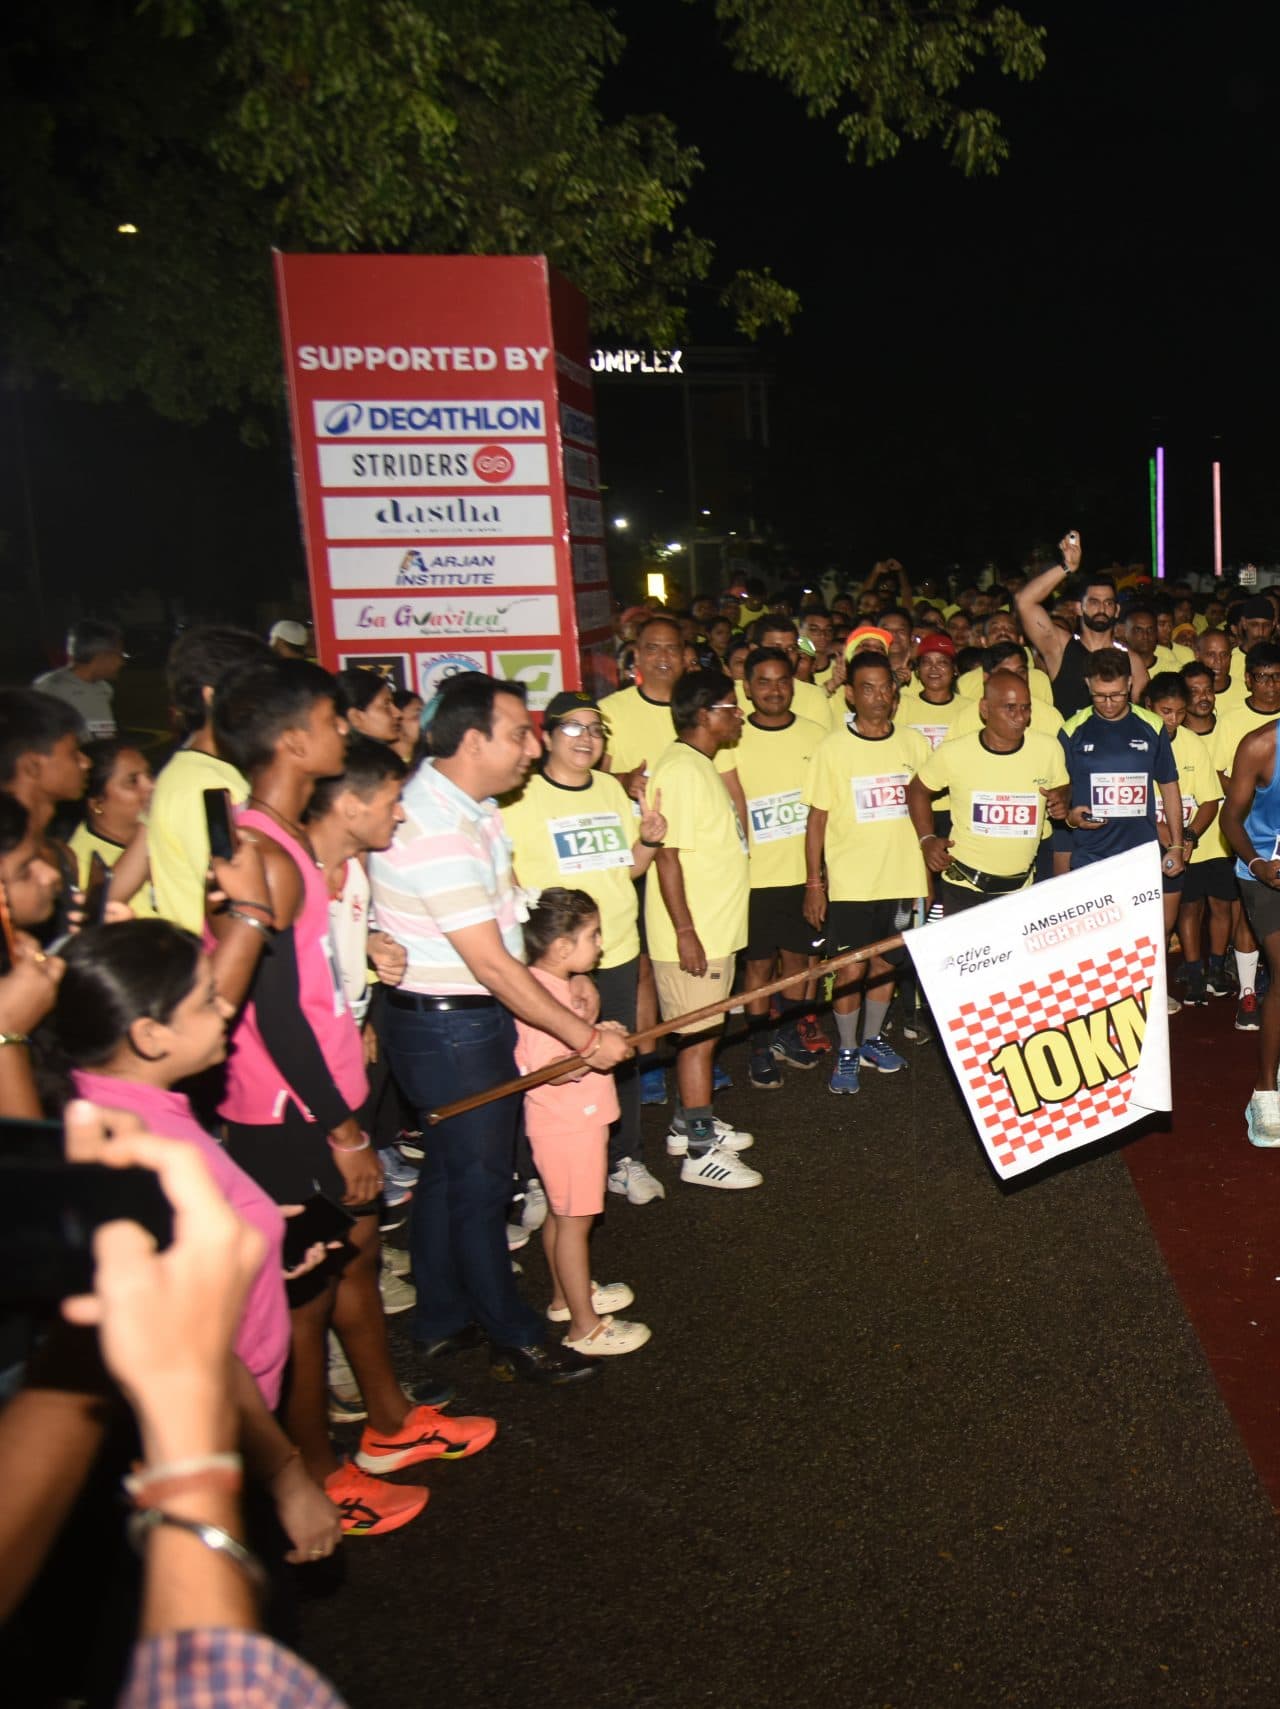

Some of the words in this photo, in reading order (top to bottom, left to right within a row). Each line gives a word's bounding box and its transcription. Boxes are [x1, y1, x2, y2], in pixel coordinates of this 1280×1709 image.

[298, 347, 497, 372] SUPPORTED
[505, 346, 549, 371] BY
[369, 407, 540, 431] DECATHLON
[353, 453, 469, 477] STRIDERS
[431, 555, 495, 568] ARJAN
[396, 573, 496, 586] INSTITUTE
[863, 786, 906, 808] 1129
[1095, 786, 1144, 805] 1092
[979, 805, 1031, 824] 1018
[563, 828, 620, 856] 1213
[1021, 894, 1115, 936] JAMSHEDPUR
[1131, 889, 1161, 906] 2025
[1026, 922, 1081, 951] NIGHT
[1086, 908, 1121, 932] RUN
[960, 949, 1013, 976] Forever
